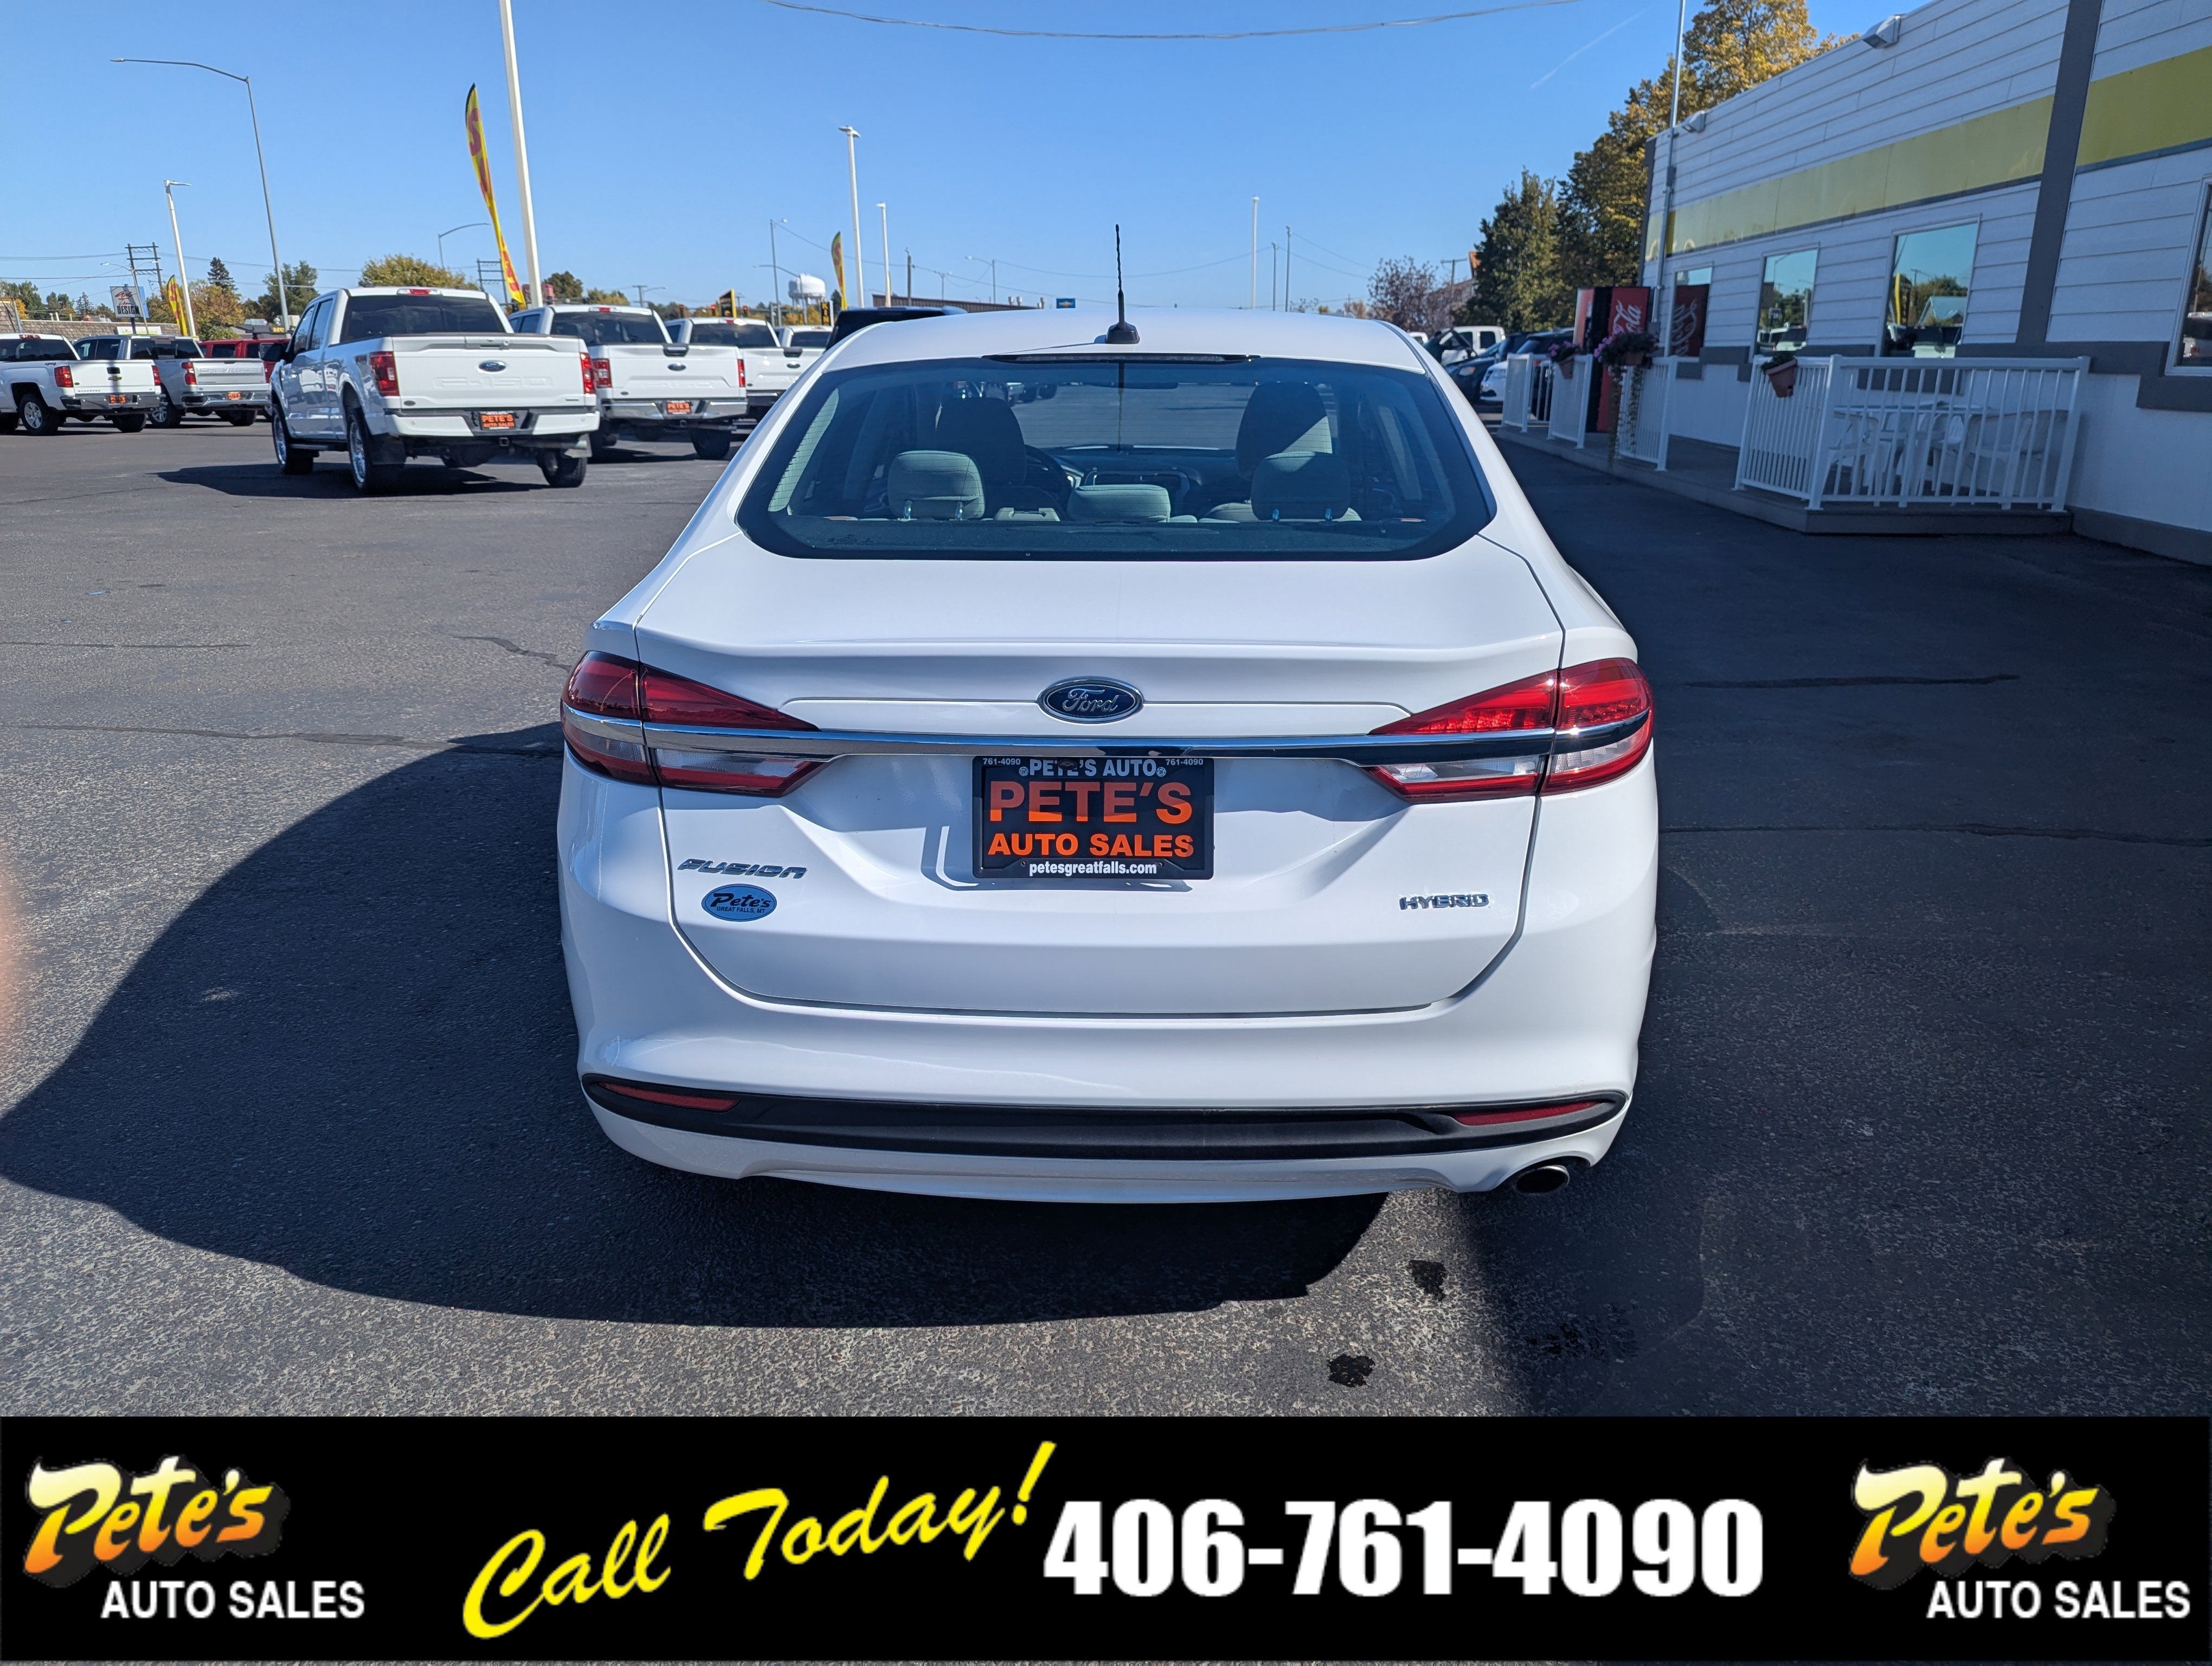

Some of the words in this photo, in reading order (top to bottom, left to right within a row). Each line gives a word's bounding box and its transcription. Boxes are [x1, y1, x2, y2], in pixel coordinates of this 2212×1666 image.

[117, 305, 140, 315] DESIGN
[1613, 299, 1643, 333] ola
[434, 377, 554, 389] F-150
[1063, 688, 1120, 712] Ford
[1103, 759, 1156, 776] AUTO
[989, 781, 1193, 824] PETE'S
[987, 833, 1079, 856] AUTO
[1089, 834, 1194, 857] SALES
[677, 858, 808, 879] FUSION
[1029, 860, 1157, 877] petesgreatfalls.com
[710, 893, 771, 908] Pete's
[1399, 894, 1490, 911] HYBRID
